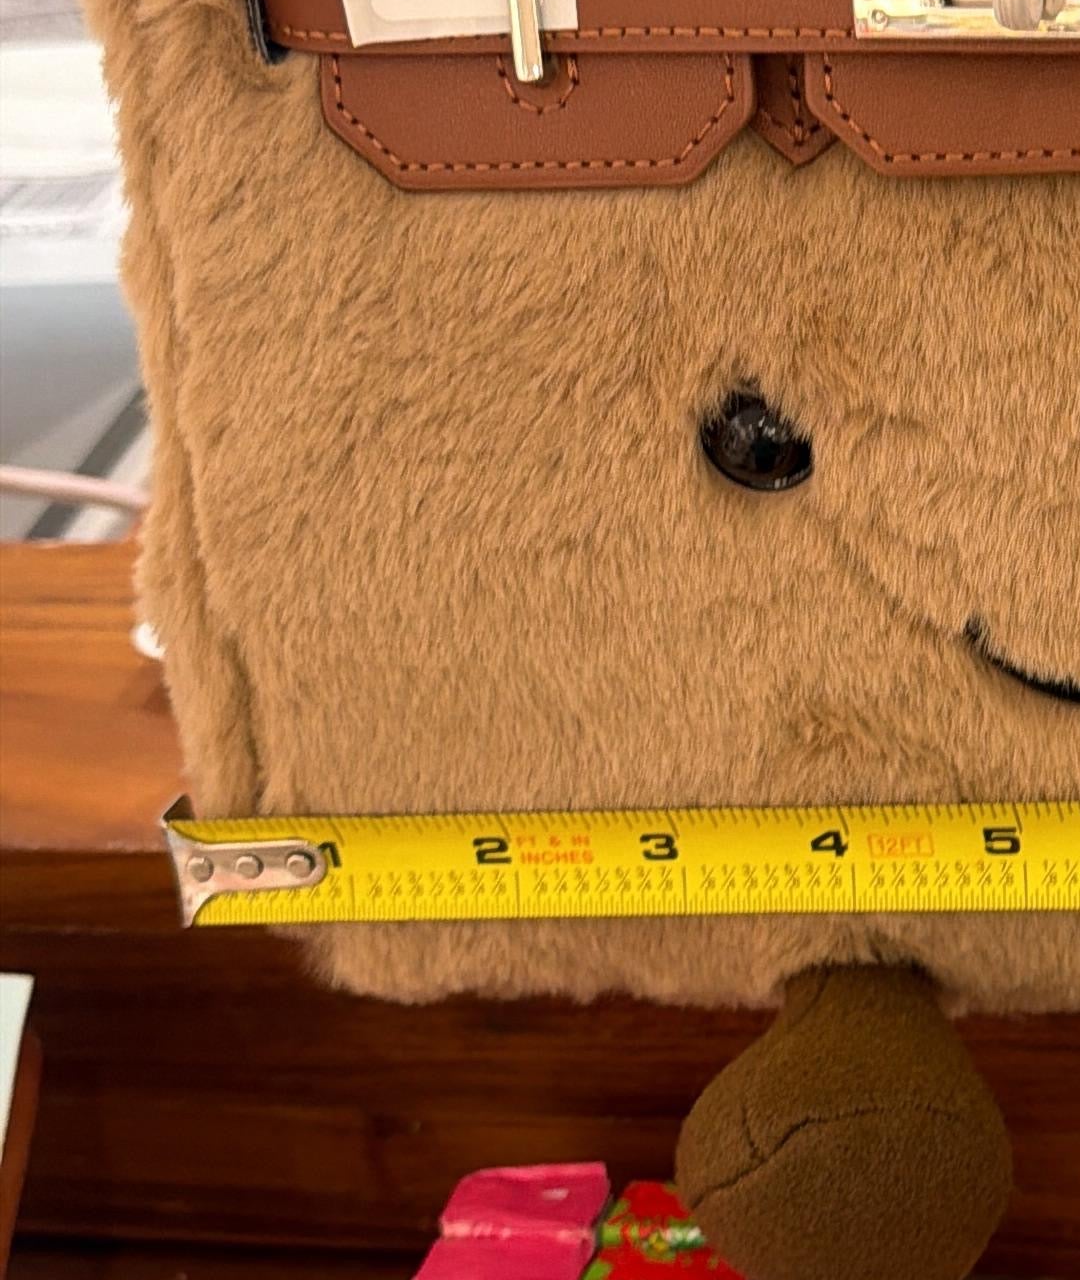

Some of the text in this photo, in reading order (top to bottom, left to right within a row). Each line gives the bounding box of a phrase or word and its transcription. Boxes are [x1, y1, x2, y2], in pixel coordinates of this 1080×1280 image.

[473, 836, 511, 865] 2
[640, 833, 678, 860] 3
[811, 830, 848, 857] 4
[983, 826, 1021, 855] 5
[318, 841, 342, 868] 1
[521, 850, 593, 865] INCHES
